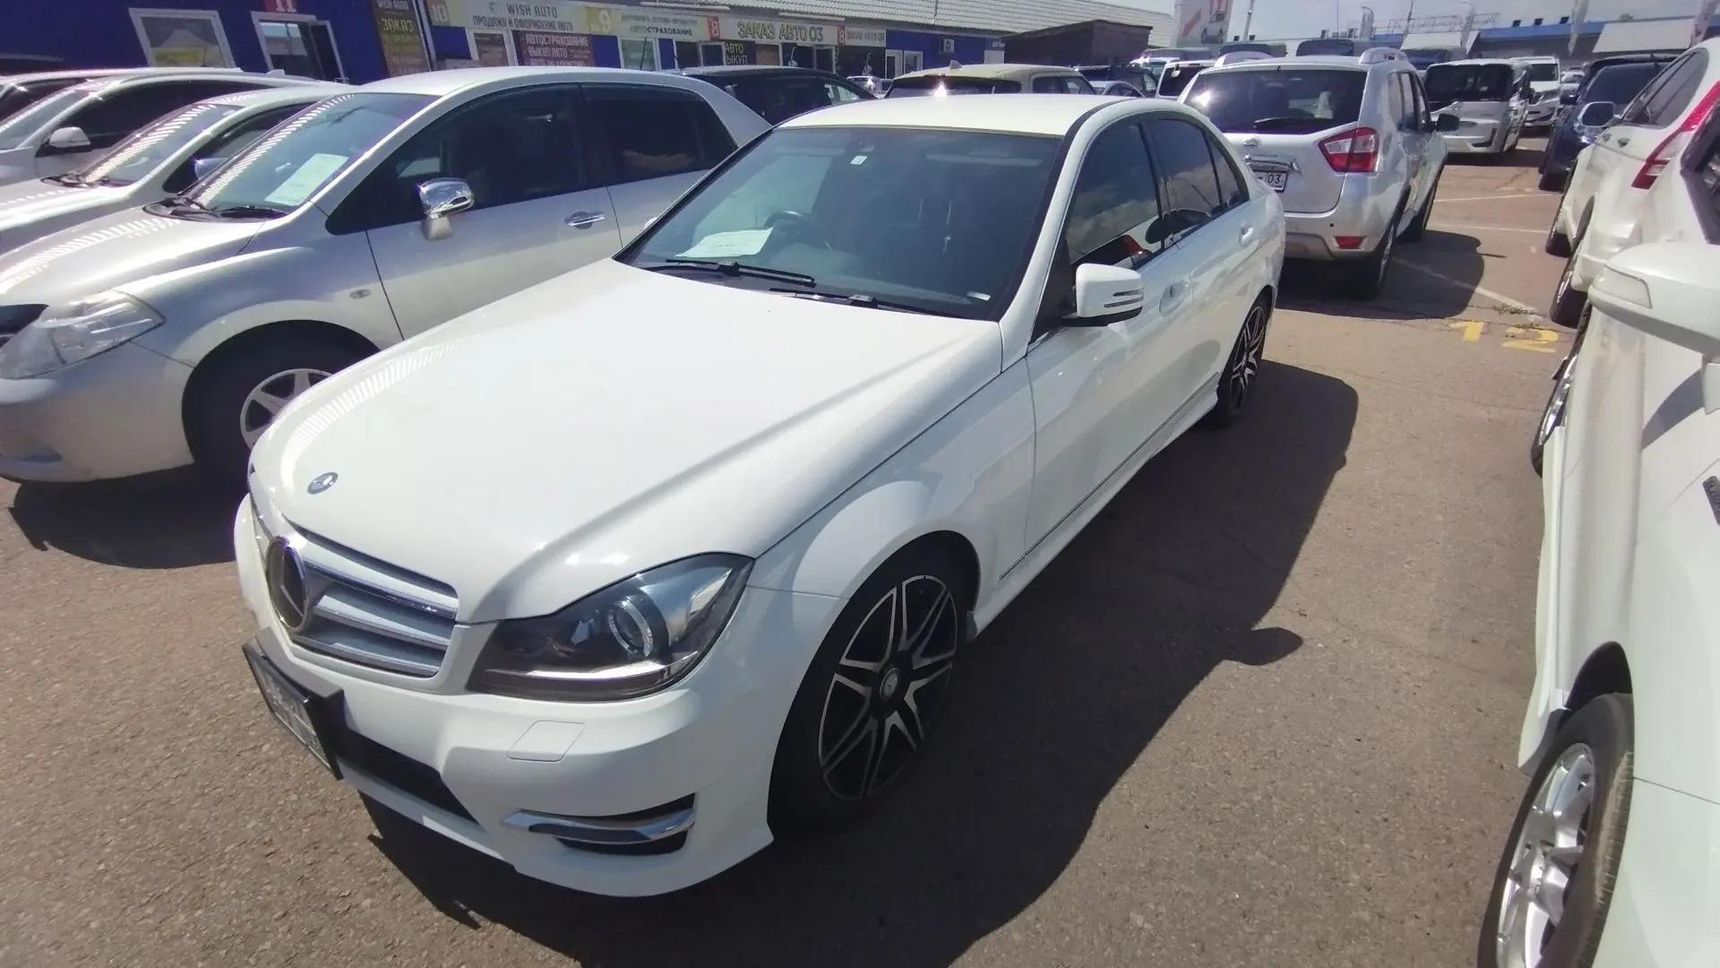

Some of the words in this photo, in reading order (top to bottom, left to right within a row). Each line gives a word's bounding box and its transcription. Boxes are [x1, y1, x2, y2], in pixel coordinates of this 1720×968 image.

[506, 3, 532, 16] WISH
[778, 24, 808, 41] АВТО
[1267, 173, 1281, 185] 03
